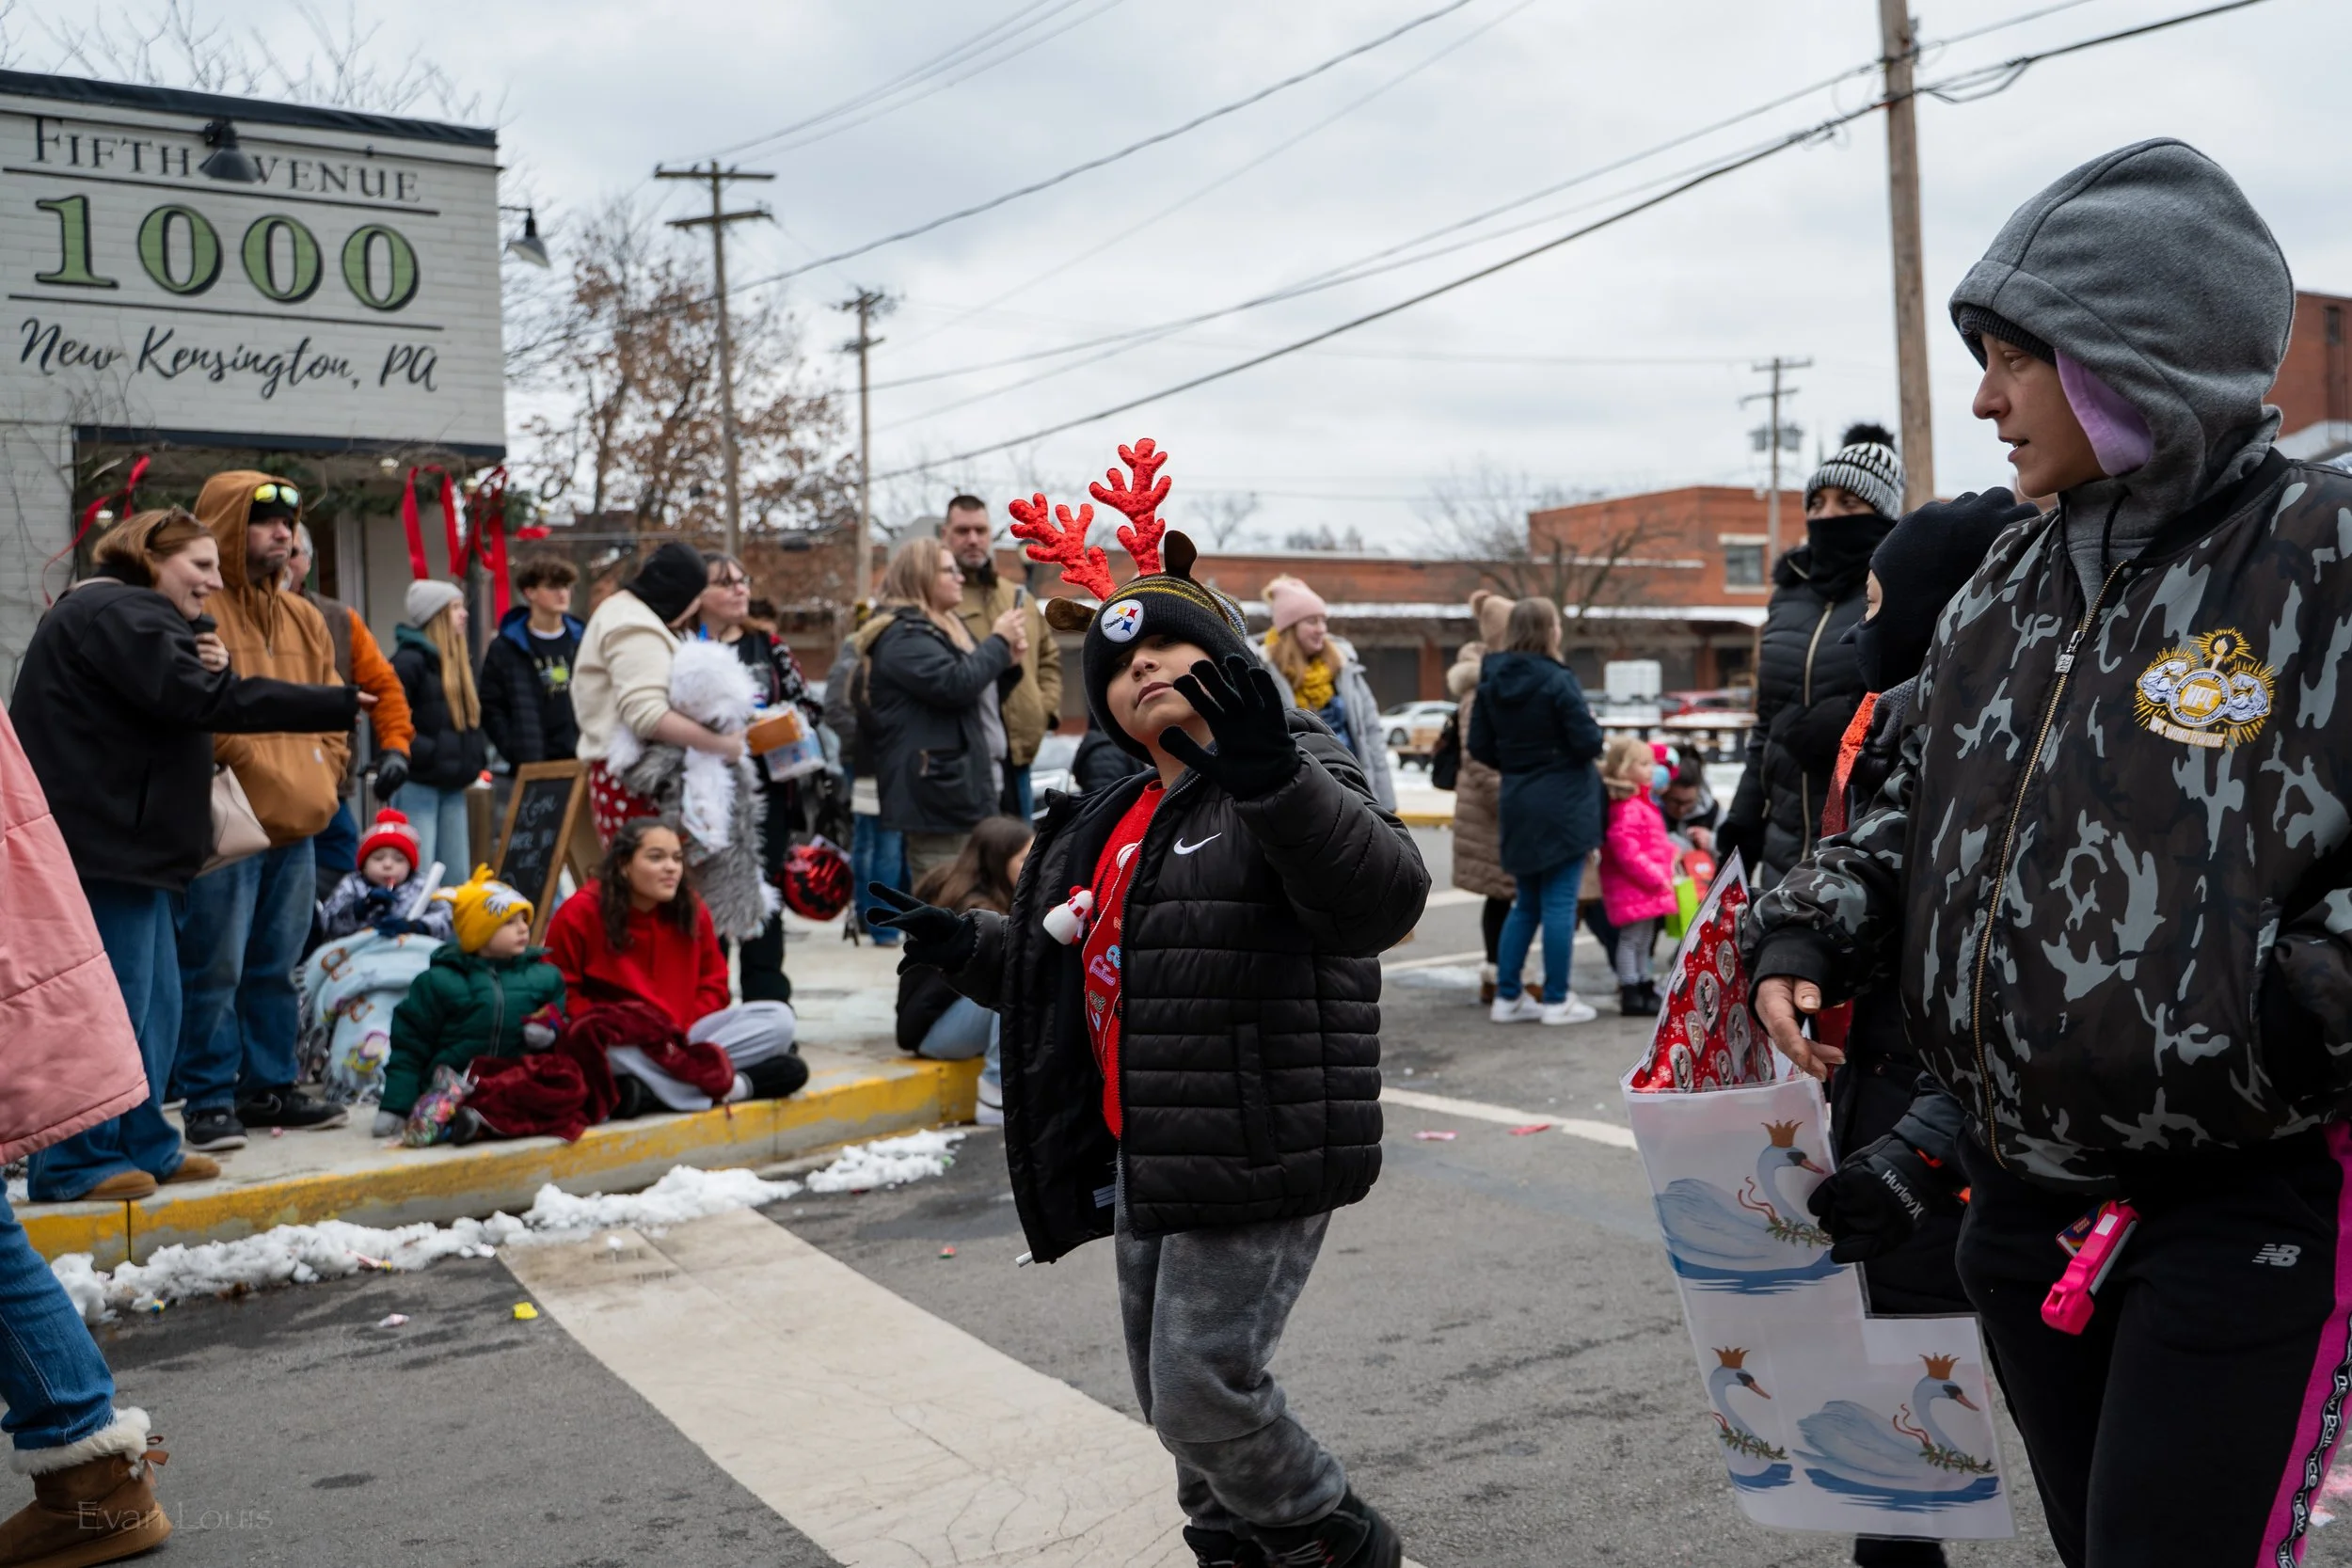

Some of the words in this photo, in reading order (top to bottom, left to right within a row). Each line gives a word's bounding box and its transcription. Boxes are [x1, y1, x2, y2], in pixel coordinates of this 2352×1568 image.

[251, 154, 421, 204] VENUE
[34, 194, 421, 313] 1000
[20, 316, 124, 377] New
[137, 324, 360, 400] Kensington,
[378, 341, 438, 393] PA
[2182, 683, 2220, 710] NPC
[1881, 1169, 1916, 1208] Hurley
[2295, 1492, 2305, 1533] new
